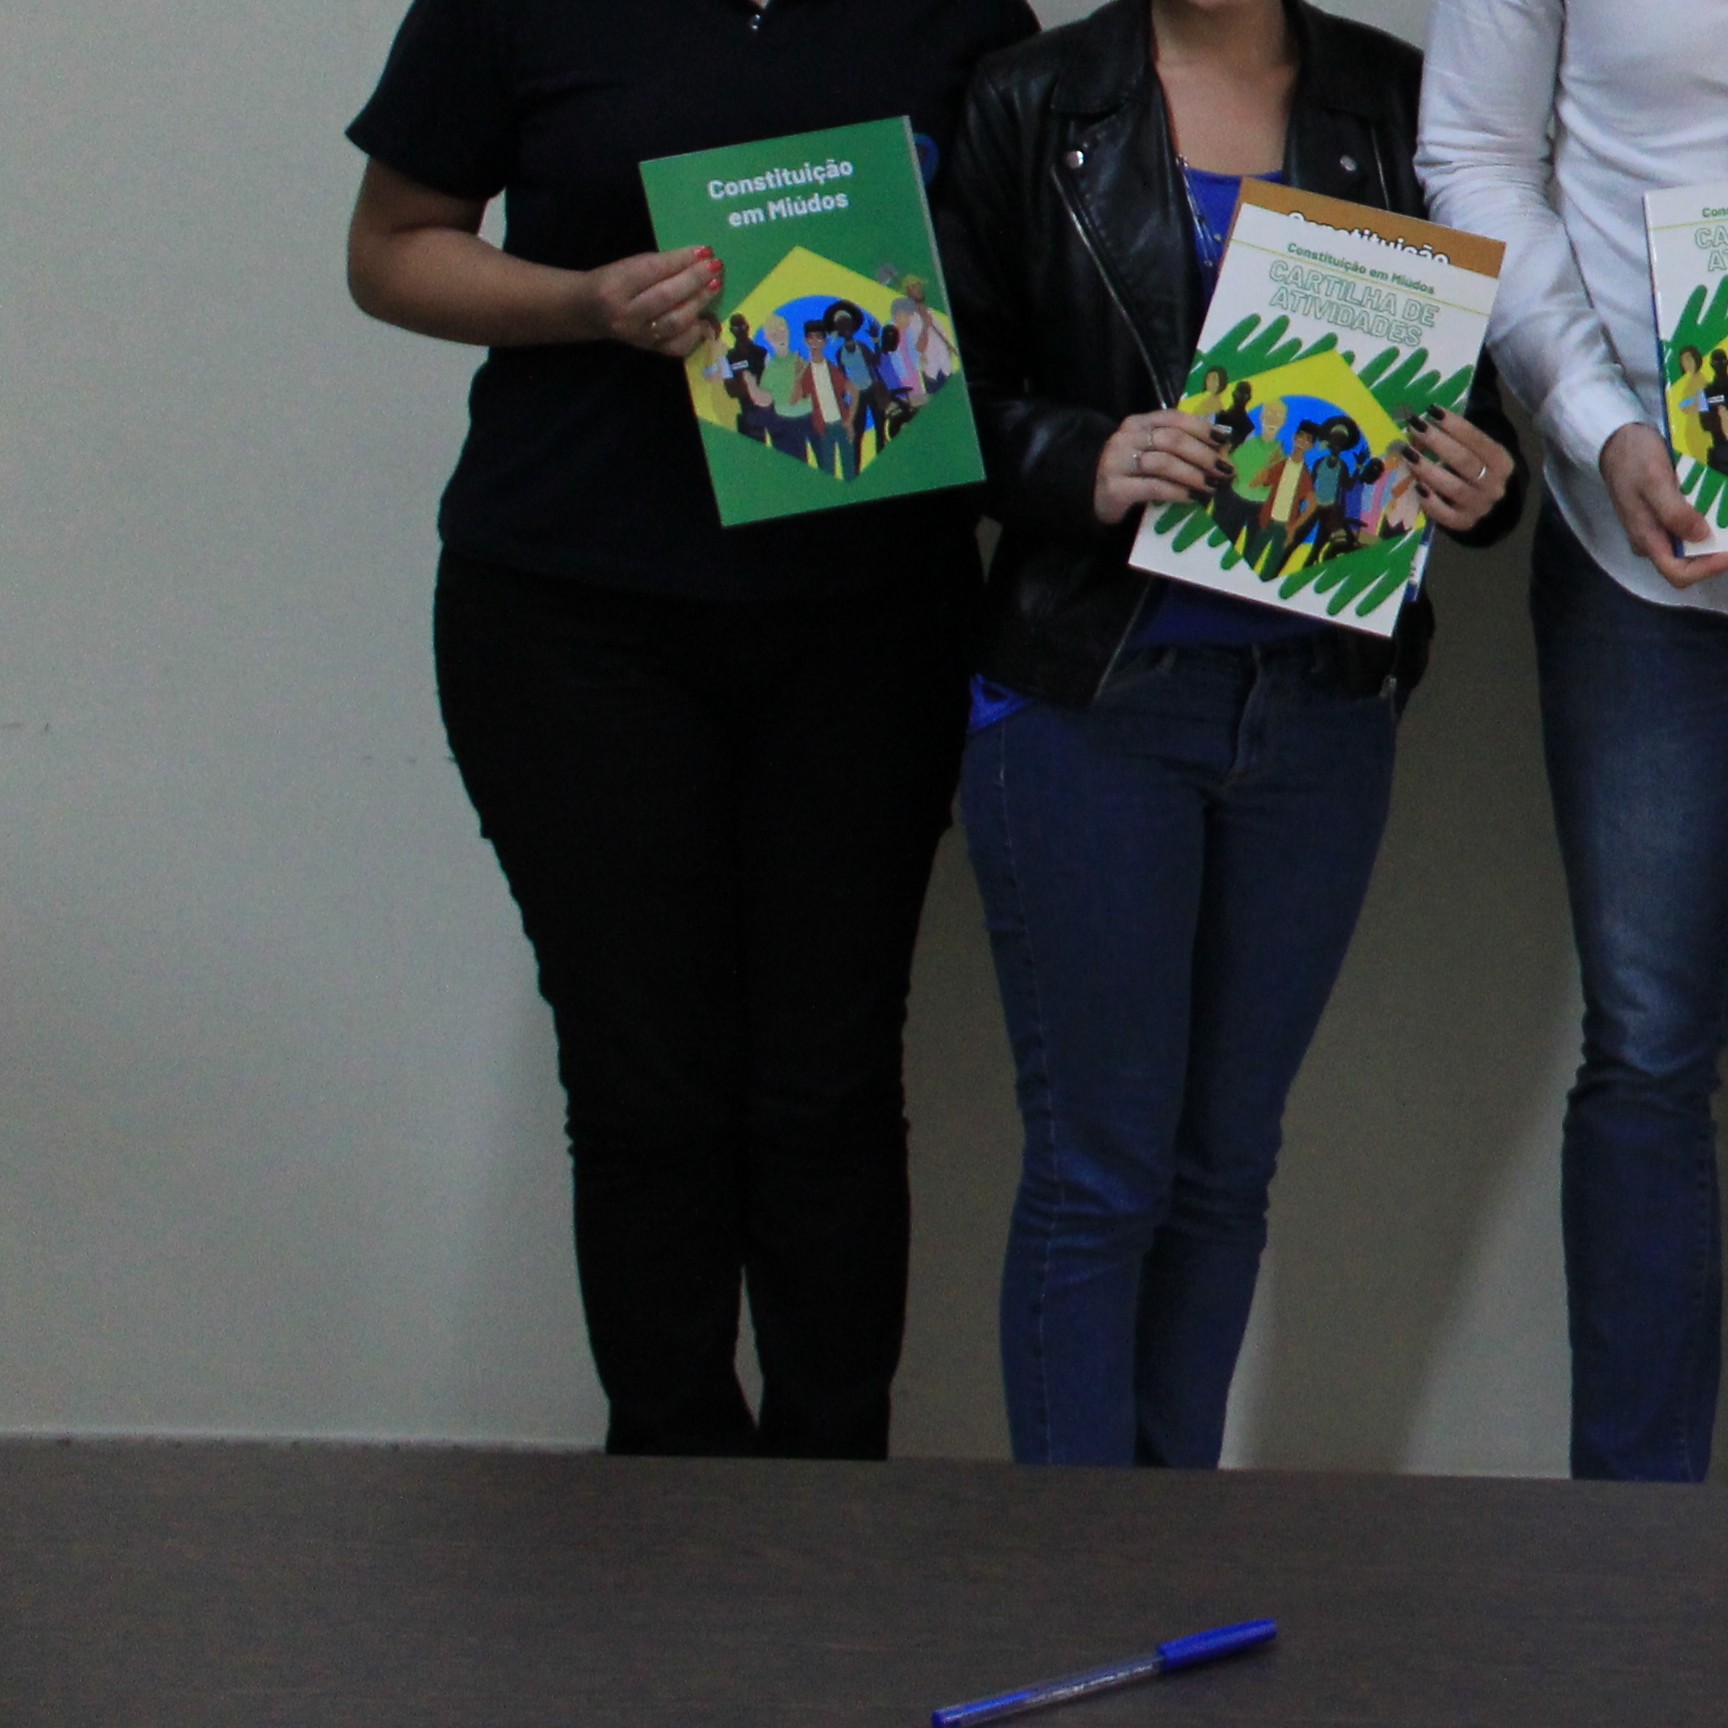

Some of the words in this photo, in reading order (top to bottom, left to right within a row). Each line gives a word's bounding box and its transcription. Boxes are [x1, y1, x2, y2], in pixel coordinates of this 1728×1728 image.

[707, 159, 854, 200] Constituição
[728, 208, 765, 228] em
[767, 192, 849, 221] Miúdos
[1269, 260, 1398, 316] CARTILHA
[1401, 298, 1441, 328] DE
[1369, 268, 1389, 281] em
[1269, 286, 1423, 348] ATIVIDADES
